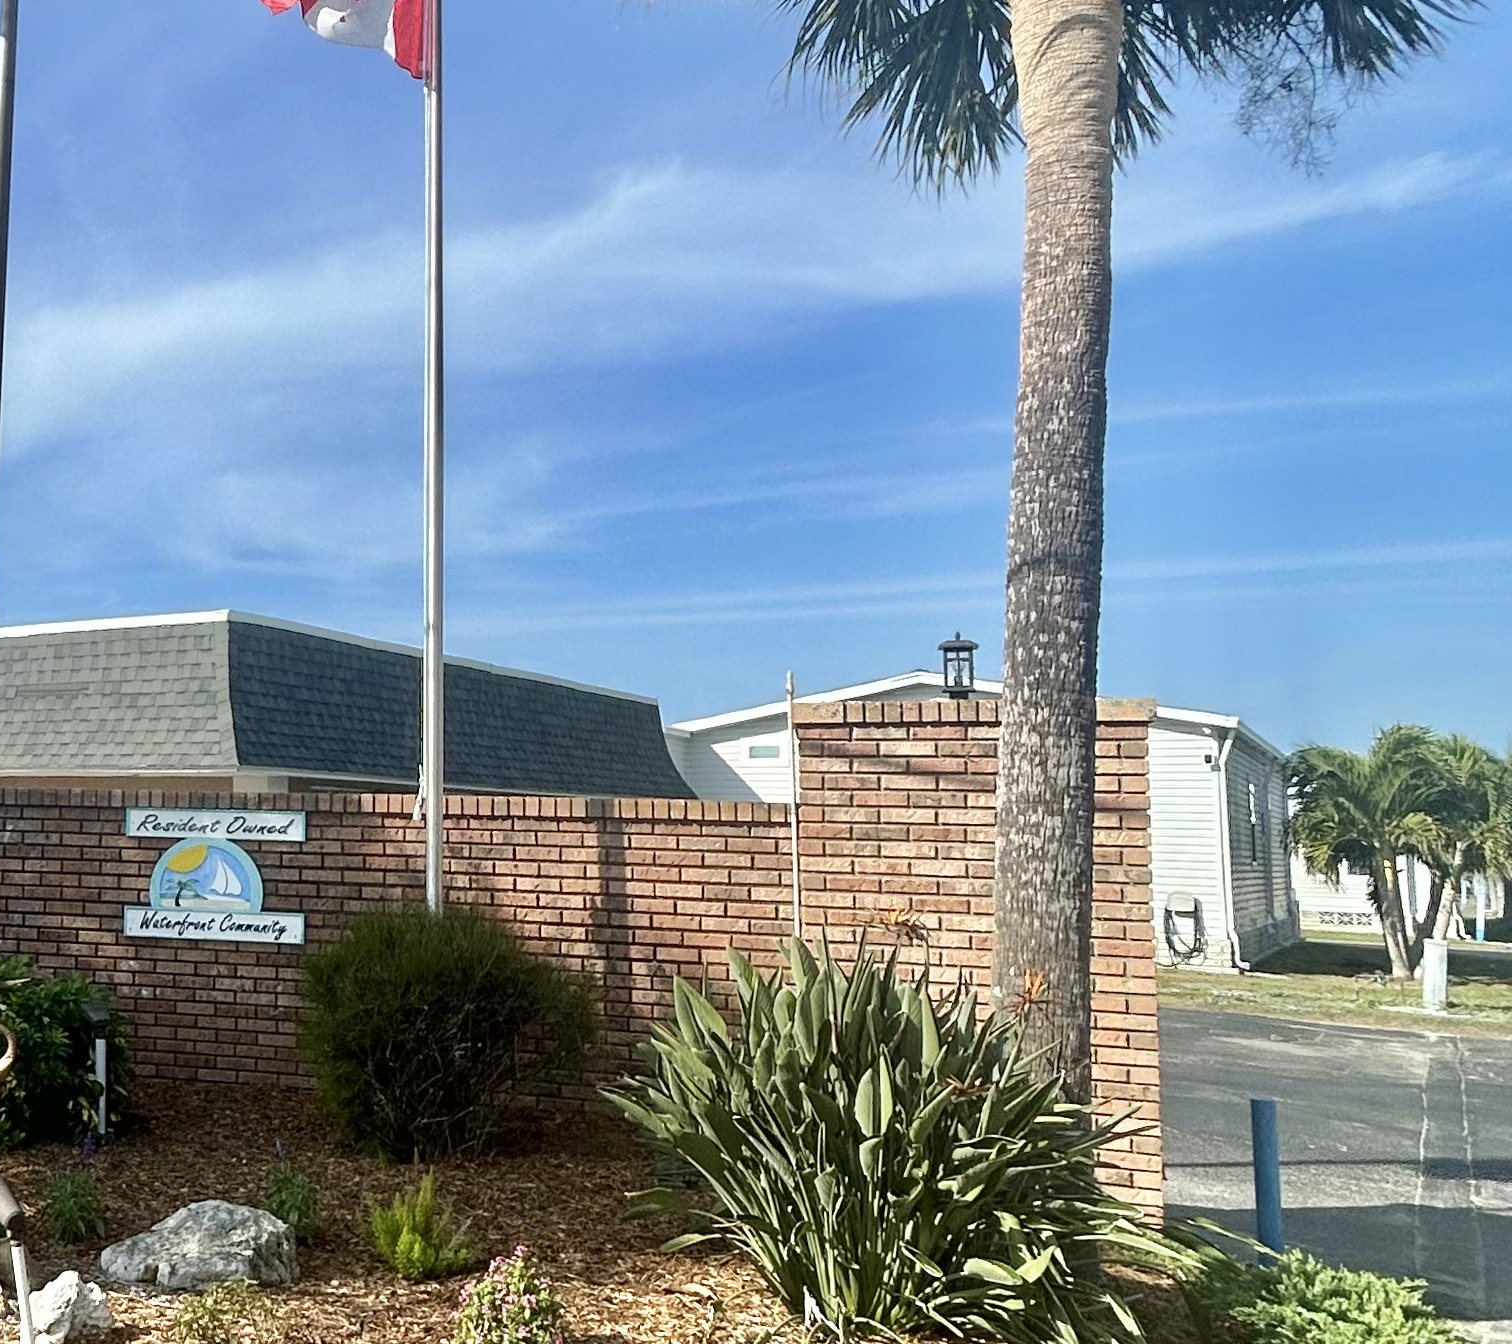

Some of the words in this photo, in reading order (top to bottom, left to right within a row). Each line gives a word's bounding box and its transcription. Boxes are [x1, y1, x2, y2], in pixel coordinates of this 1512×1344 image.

[137, 813, 220, 833] Resident
[226, 816, 295, 835] Owned
[139, 911, 215, 935] Waterfront
[219, 913, 287, 940] Community
